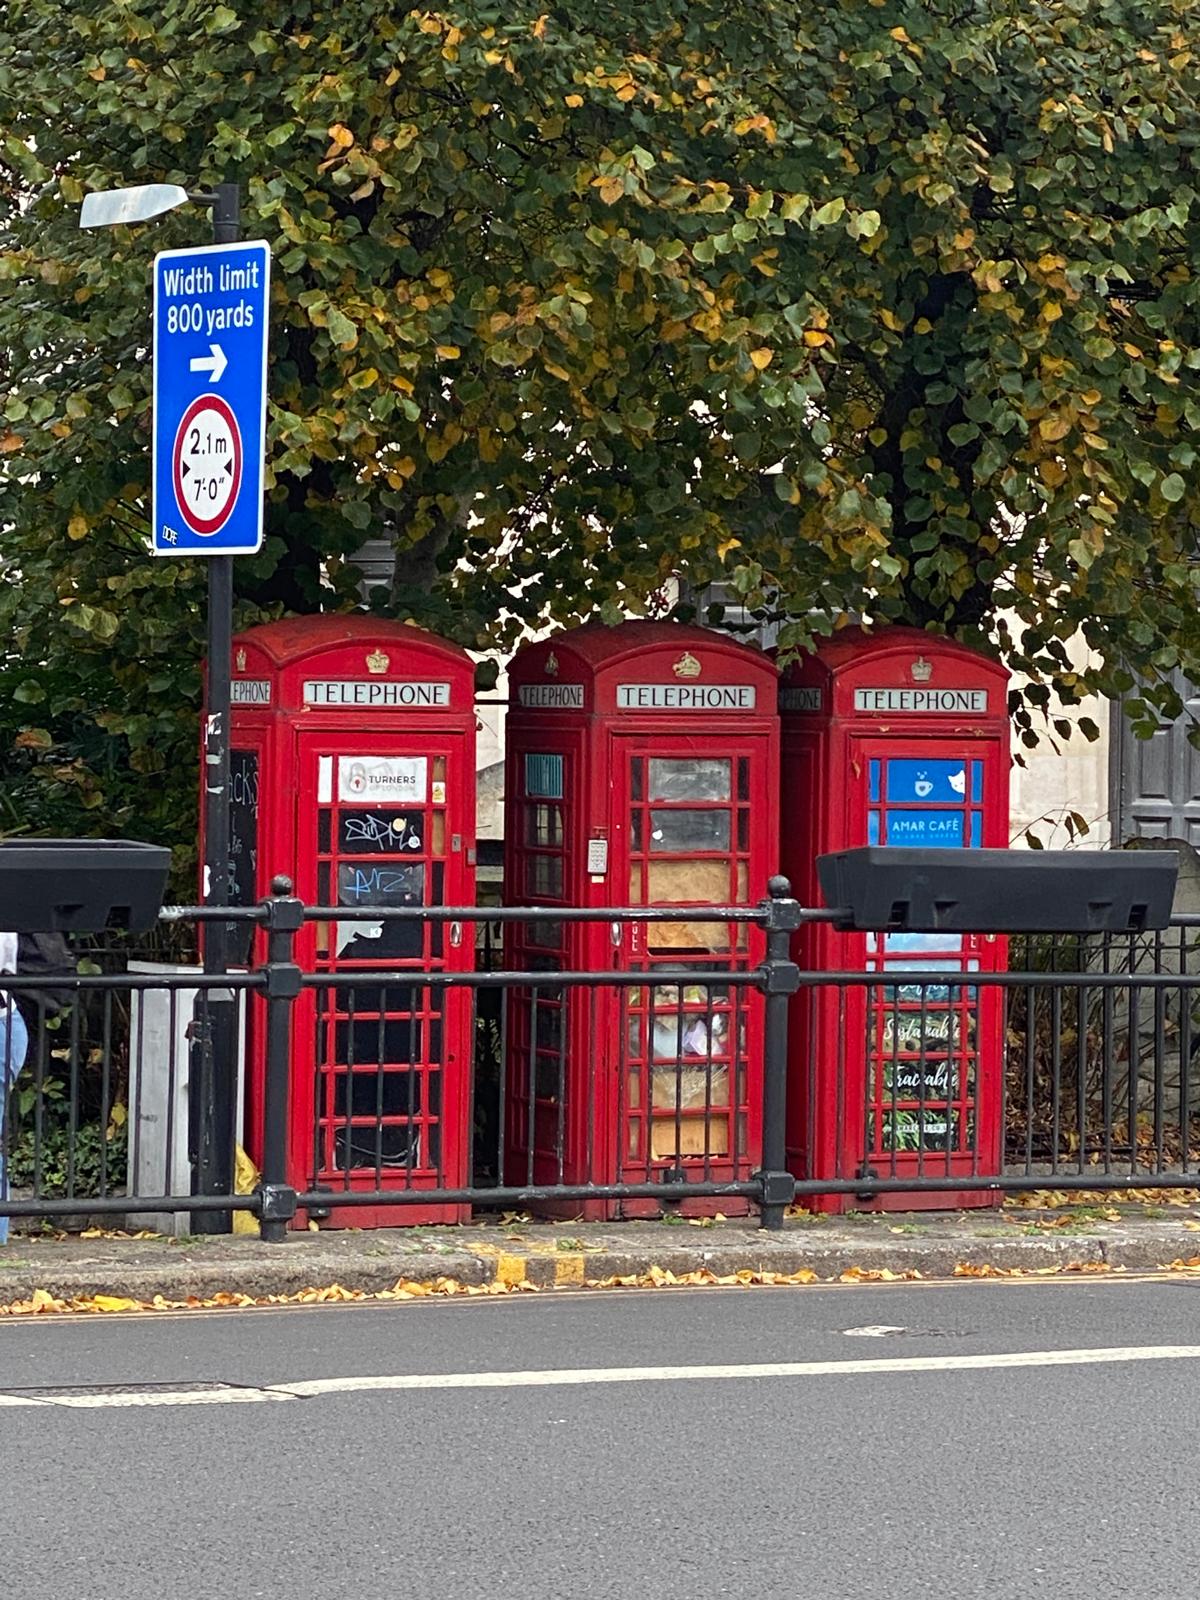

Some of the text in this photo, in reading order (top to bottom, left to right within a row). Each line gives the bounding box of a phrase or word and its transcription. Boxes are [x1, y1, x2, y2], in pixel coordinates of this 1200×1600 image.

[163, 261, 259, 297] Width limit
[167, 299, 254, 337] 800 yards
[231, 681, 270, 701] EPHONE
[308, 683, 445, 704] TELEPHONE
[521, 686, 583, 706] TELEPHONE
[622, 687, 749, 707] TELEPHONE
[859, 690, 982, 710] TELEPHONE
[368, 775, 416, 784] TURNERS
[892, 817, 959, 832] AMAR CAFÉ
[886, 1062, 960, 1090] Tracable
